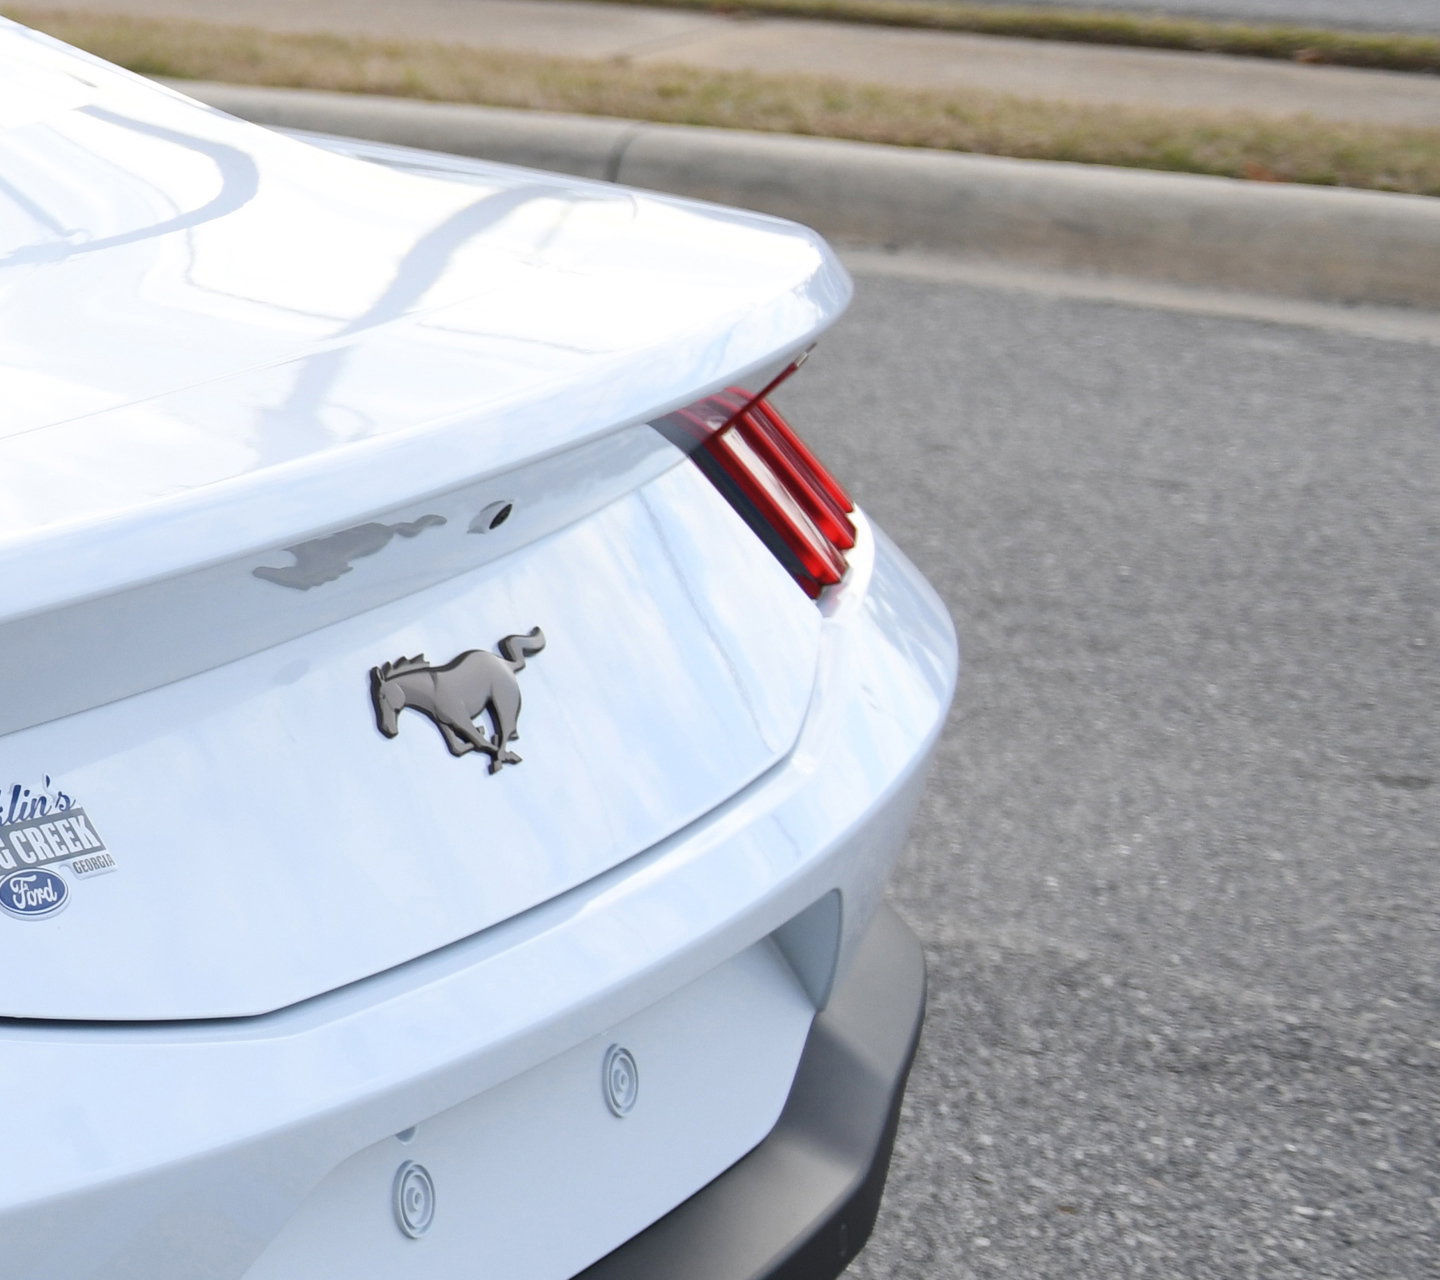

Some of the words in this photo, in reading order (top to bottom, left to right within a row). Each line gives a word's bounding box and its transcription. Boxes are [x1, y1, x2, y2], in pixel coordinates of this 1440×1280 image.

[9, 815, 101, 864] CREEK
[72, 854, 116, 874] GEORGIA
[9, 874, 58, 910] Ford
